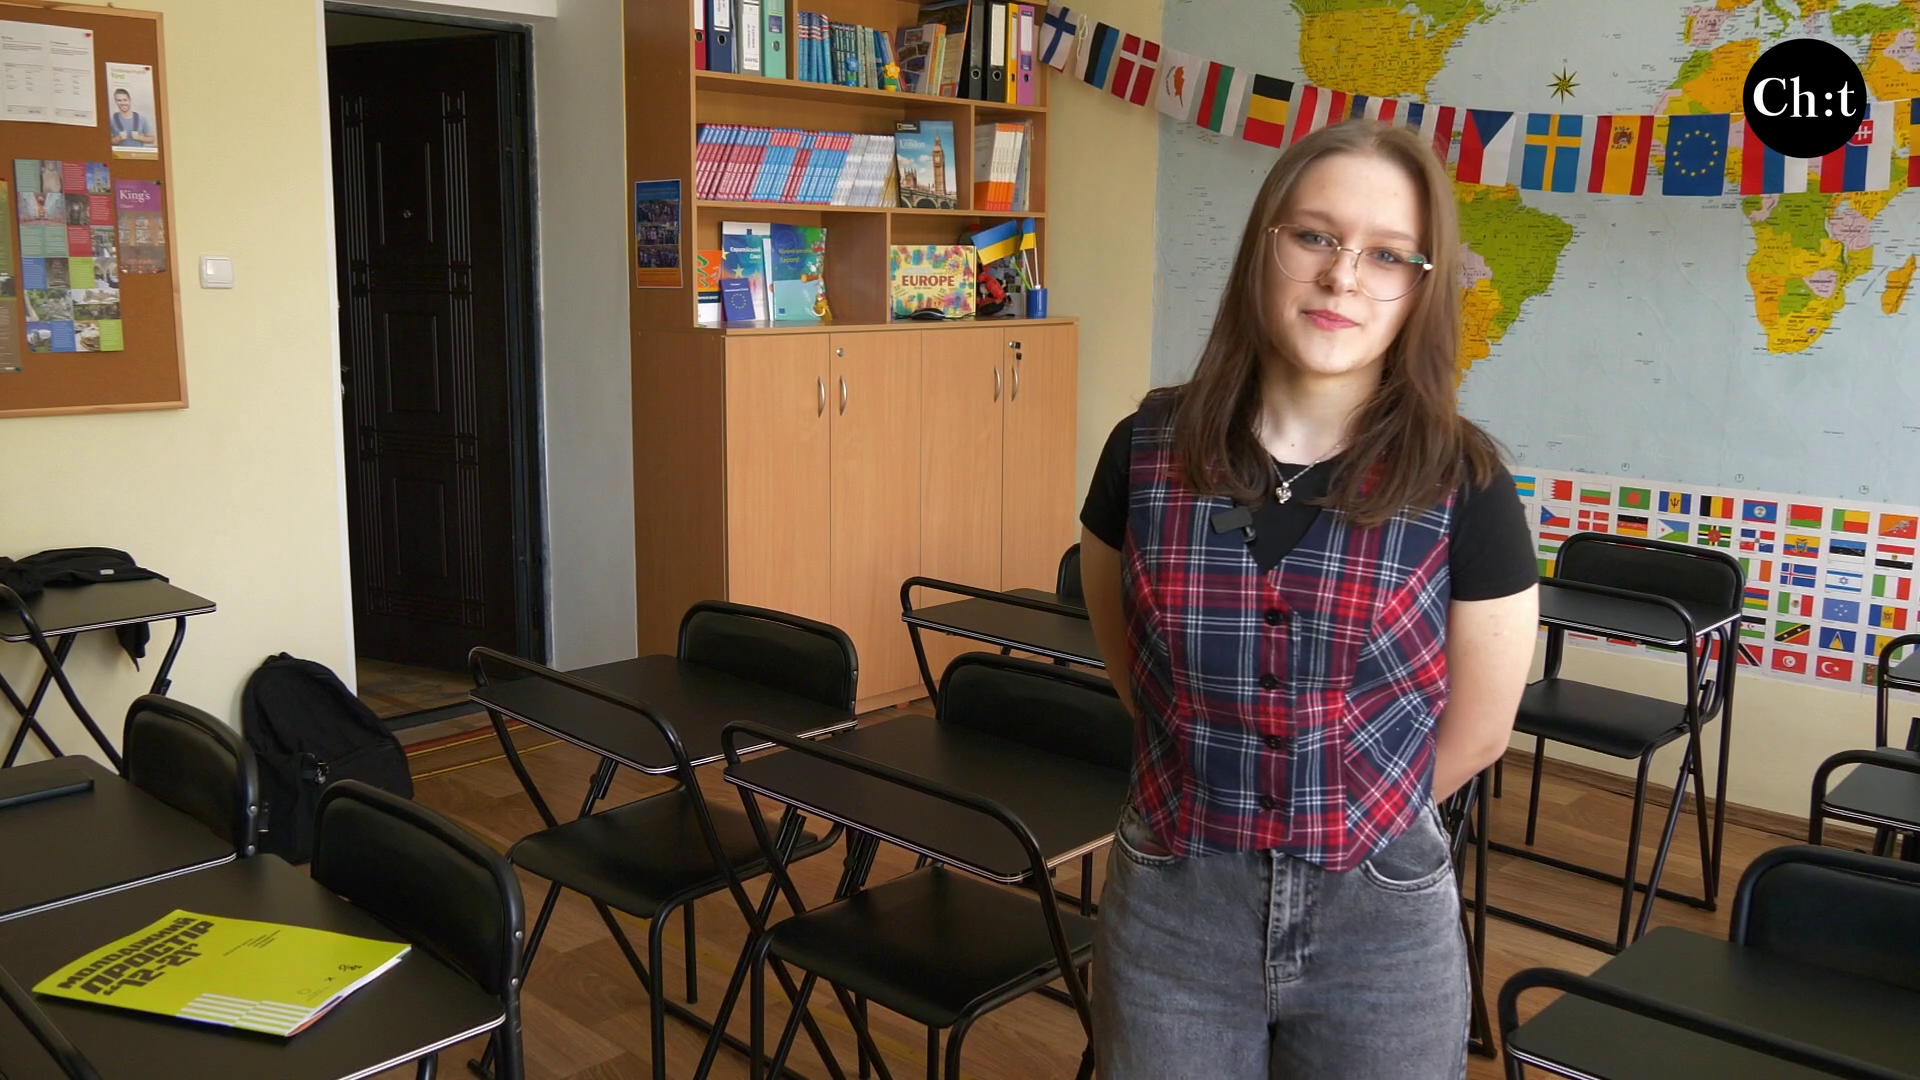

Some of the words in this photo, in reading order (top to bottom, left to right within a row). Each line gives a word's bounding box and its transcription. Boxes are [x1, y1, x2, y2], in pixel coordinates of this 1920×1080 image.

[120, 189, 151, 203] King's
[901, 275, 955, 287] EUROPE
[57, 917, 198, 989] МОЛОДІЖНИЙ
[80, 920, 215, 995] ПРОСТІР
